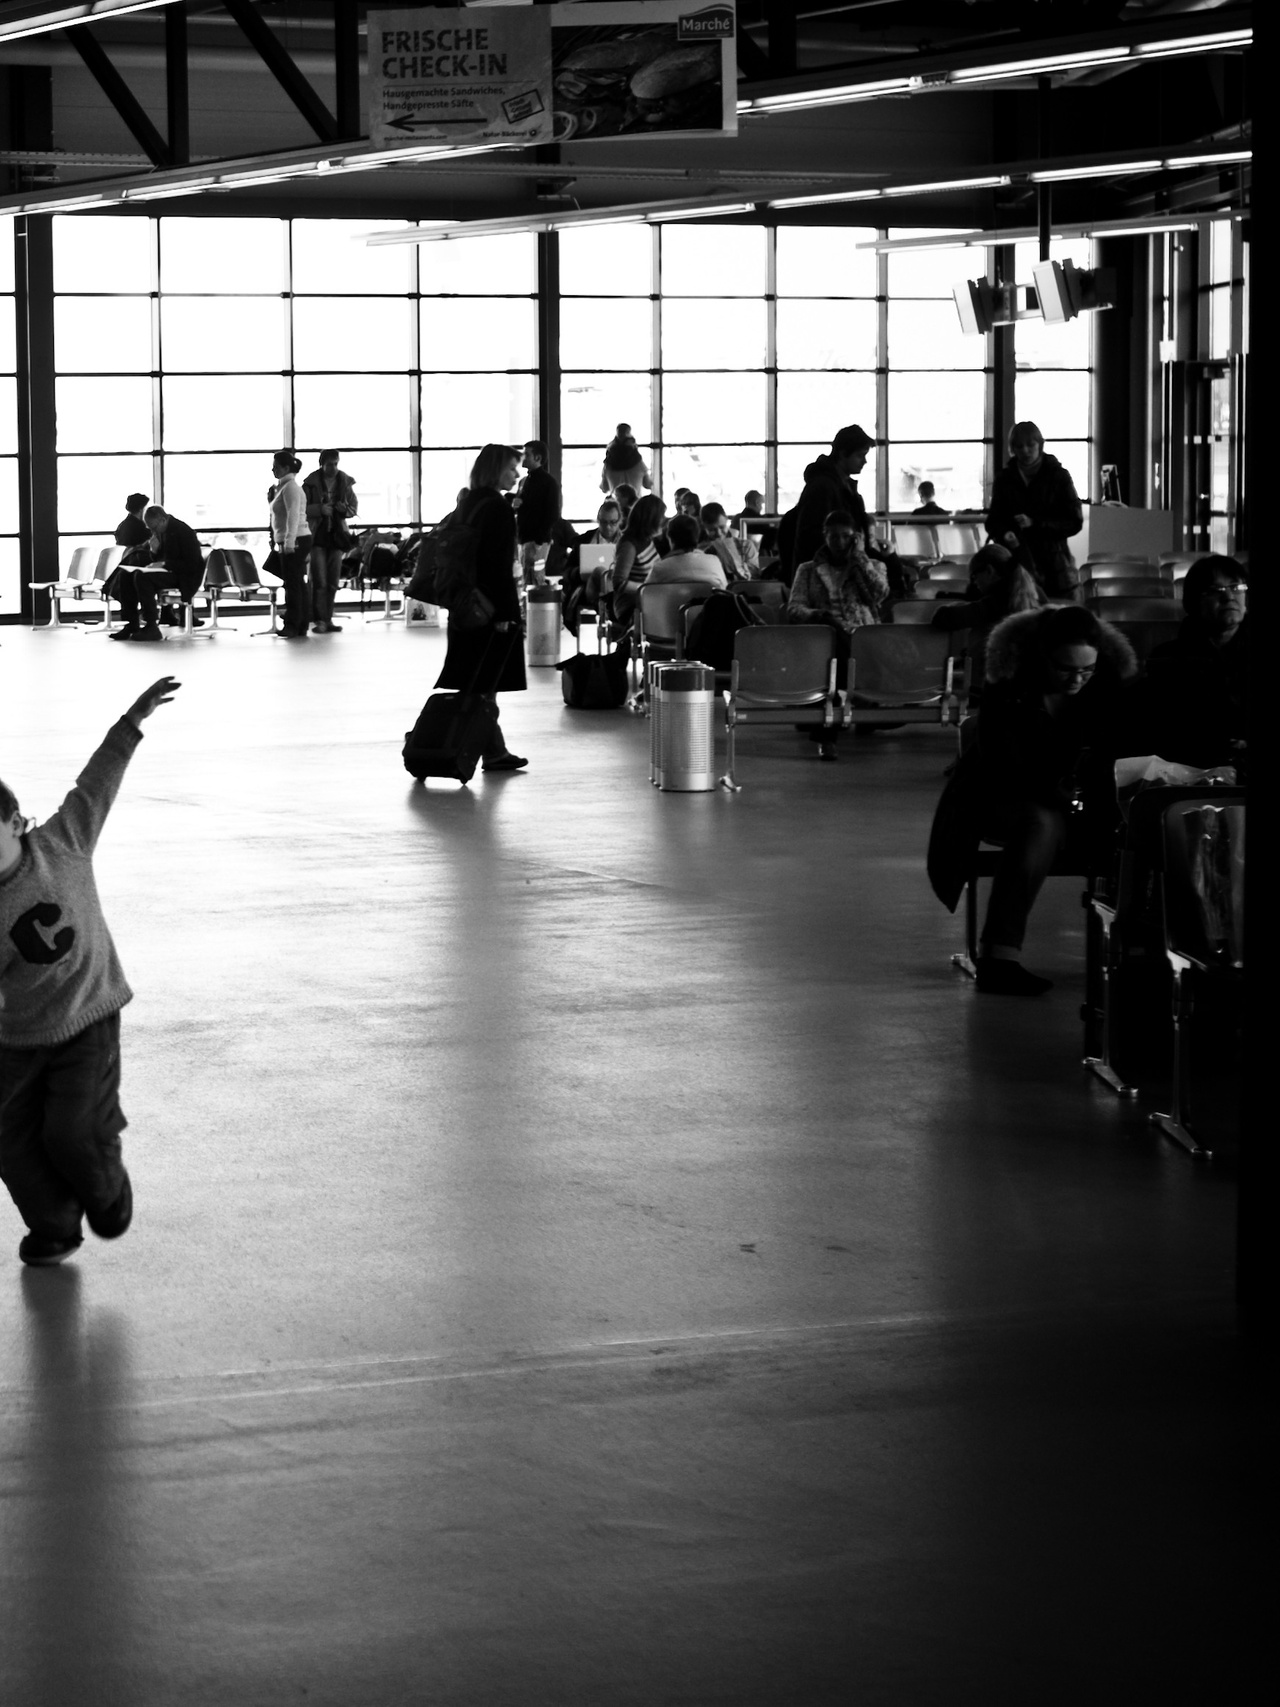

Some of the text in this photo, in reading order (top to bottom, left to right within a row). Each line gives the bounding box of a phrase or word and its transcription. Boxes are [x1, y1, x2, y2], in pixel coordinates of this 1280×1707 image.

[682, 17, 730, 31] Marché
[382, 28, 488, 53] FRISCHE
[383, 53, 507, 79] CHECK-IN
[383, 86, 507, 99] Hausgemachte Sandwiches,
[383, 99, 474, 111] Handgepresste Säfte
[10, 902, 75, 965] C
